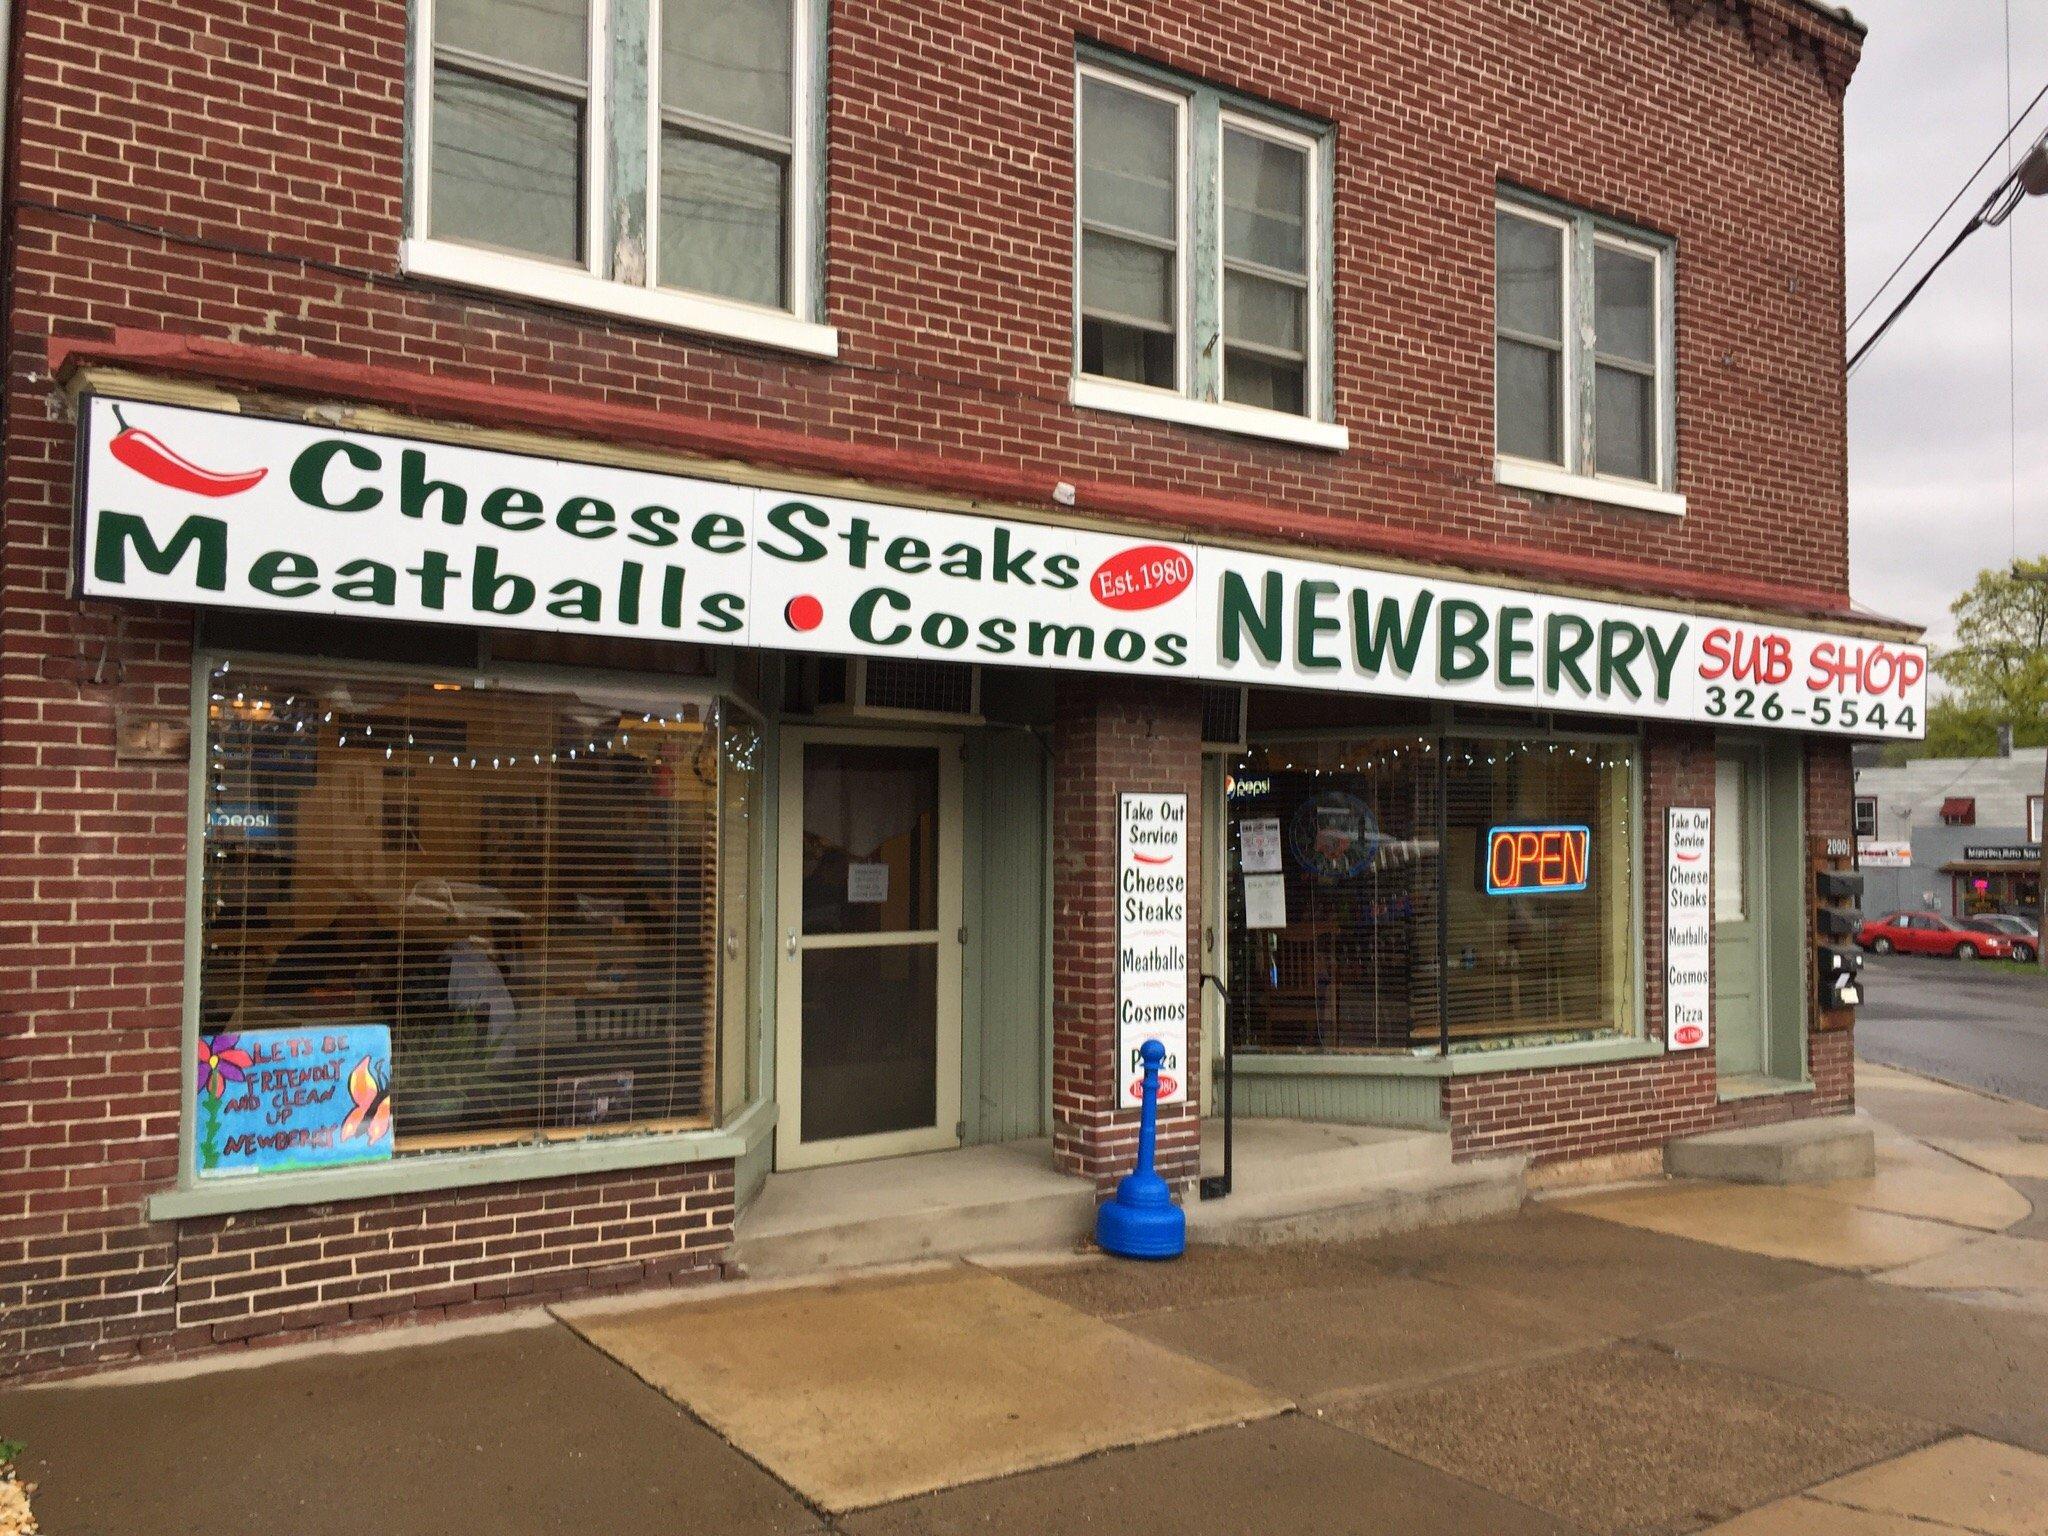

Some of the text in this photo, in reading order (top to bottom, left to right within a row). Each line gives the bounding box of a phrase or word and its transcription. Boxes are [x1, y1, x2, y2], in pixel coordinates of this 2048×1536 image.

[94, 509, 1188, 667] Meatballs Cosmos
[1219, 569, 1690, 702] NEWBERRY
[1699, 627, 1925, 699] SUB SHOP
[1703, 686, 1918, 732] 326-5544
[1123, 800, 1185, 822] Take Out
[1671, 813, 1708, 829] Take Out
[1129, 824, 1178, 844] Service
[1674, 832, 1705, 848] Service
[1491, 831, 1586, 888] OPEN
[1123, 867, 1184, 893] Cheese
[1670, 865, 1708, 886] Cheese
[1124, 896, 1183, 922] Steaks
[1670, 888, 1707, 908] Steaks
[1669, 926, 1708, 946] Meatballs
[1122, 945, 1184, 972] Meatballs
[1669, 965, 1708, 986] Cosmos
[1122, 998, 1185, 1024] Cosmos
[1674, 1004, 1703, 1024] Pizza
[321, 1035, 350, 1054] BE
[1131, 1047, 1177, 1073] Pza
[246, 1058, 345, 1096] FRIENDLY
[223, 1085, 336, 1115] AND CLEAN
[266, 1107, 293, 1126] UP
